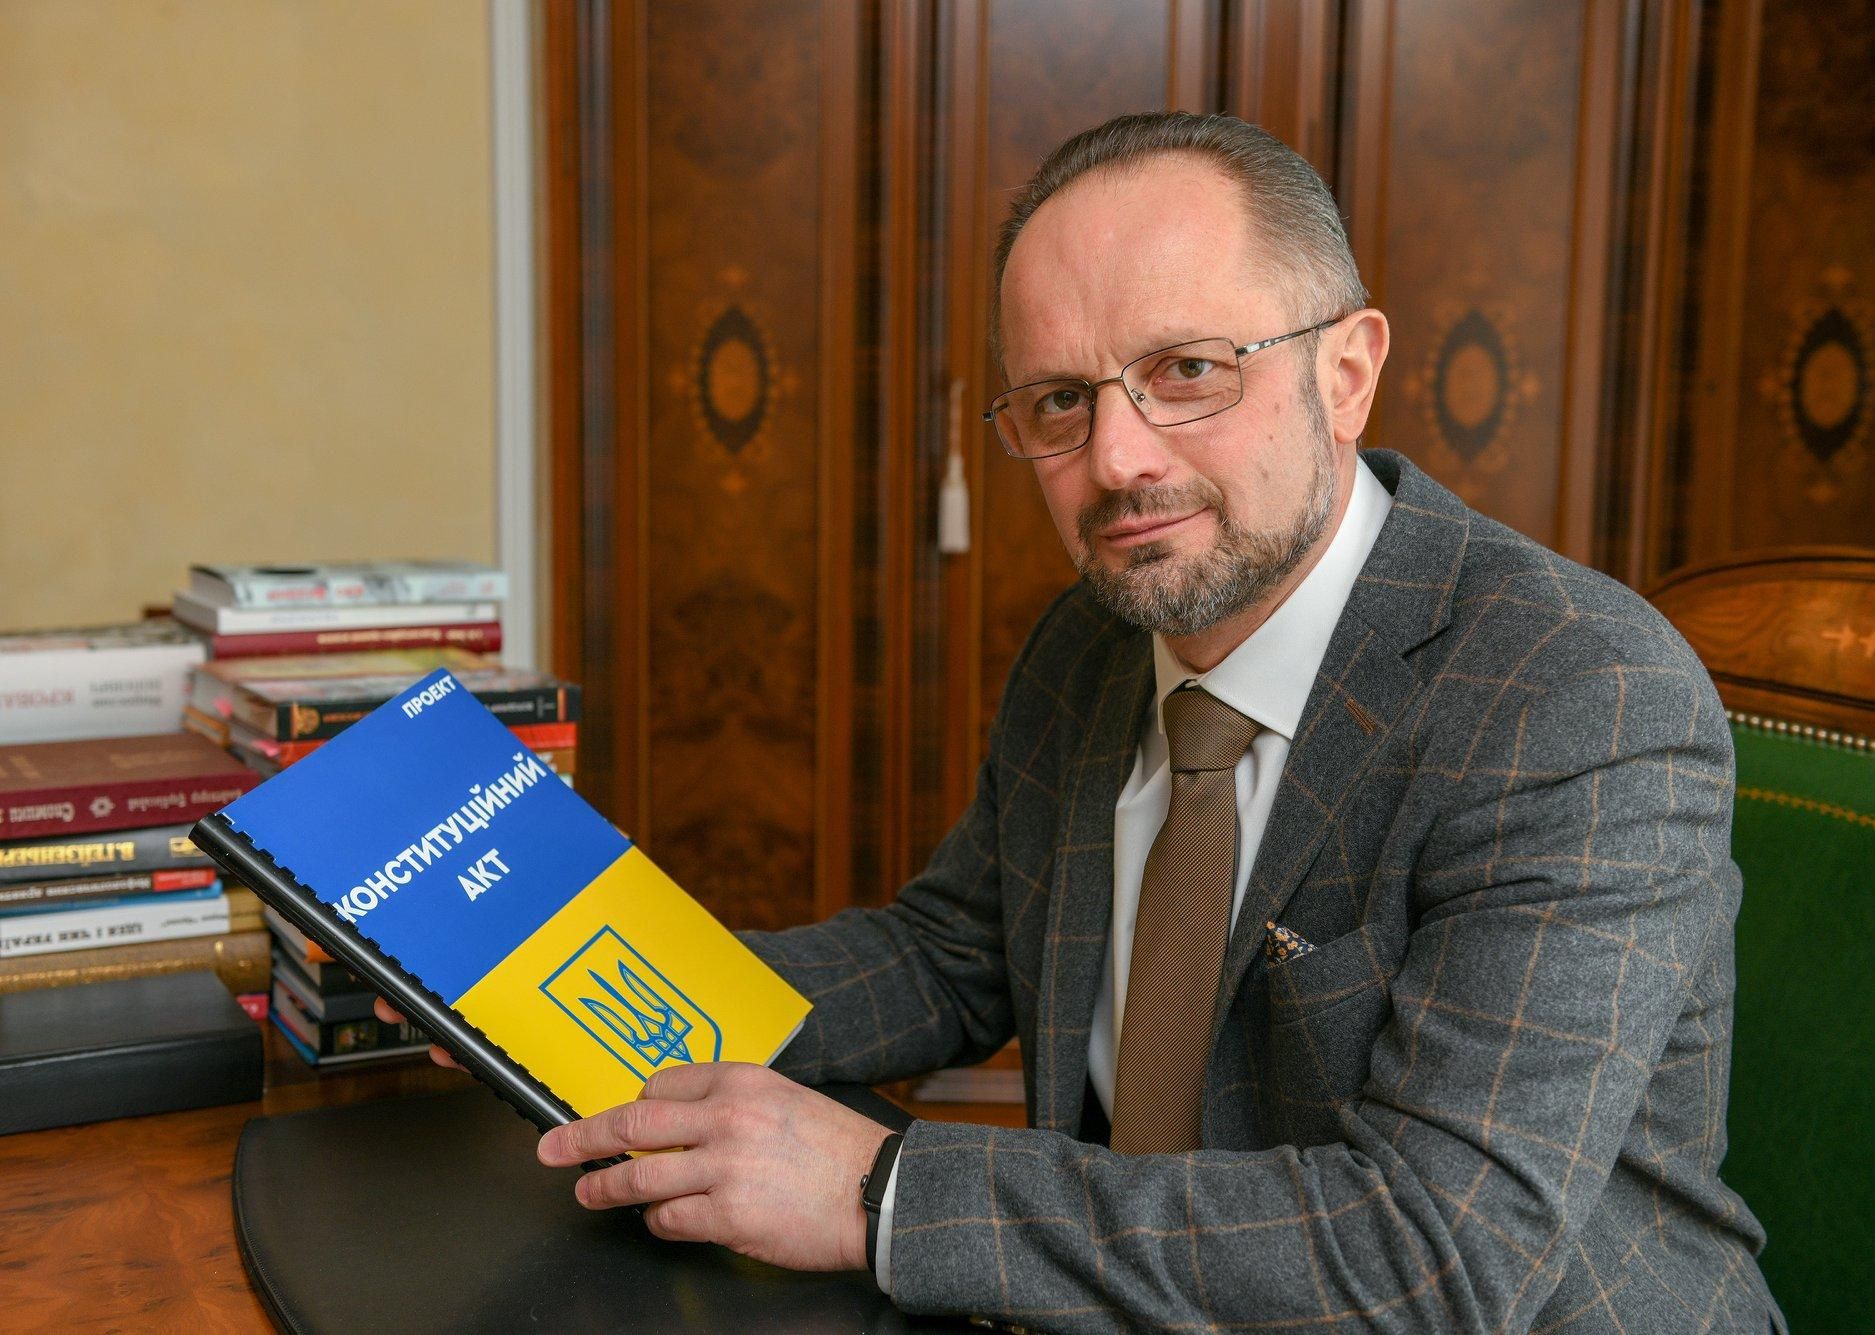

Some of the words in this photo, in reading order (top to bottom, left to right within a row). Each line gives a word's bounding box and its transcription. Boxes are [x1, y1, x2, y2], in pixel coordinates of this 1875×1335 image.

[402, 675, 456, 719] ПРОЕКТ
[332, 752, 547, 923] КОНСТИТУЦІЙНИЙ
[457, 848, 511, 902] АКТ
